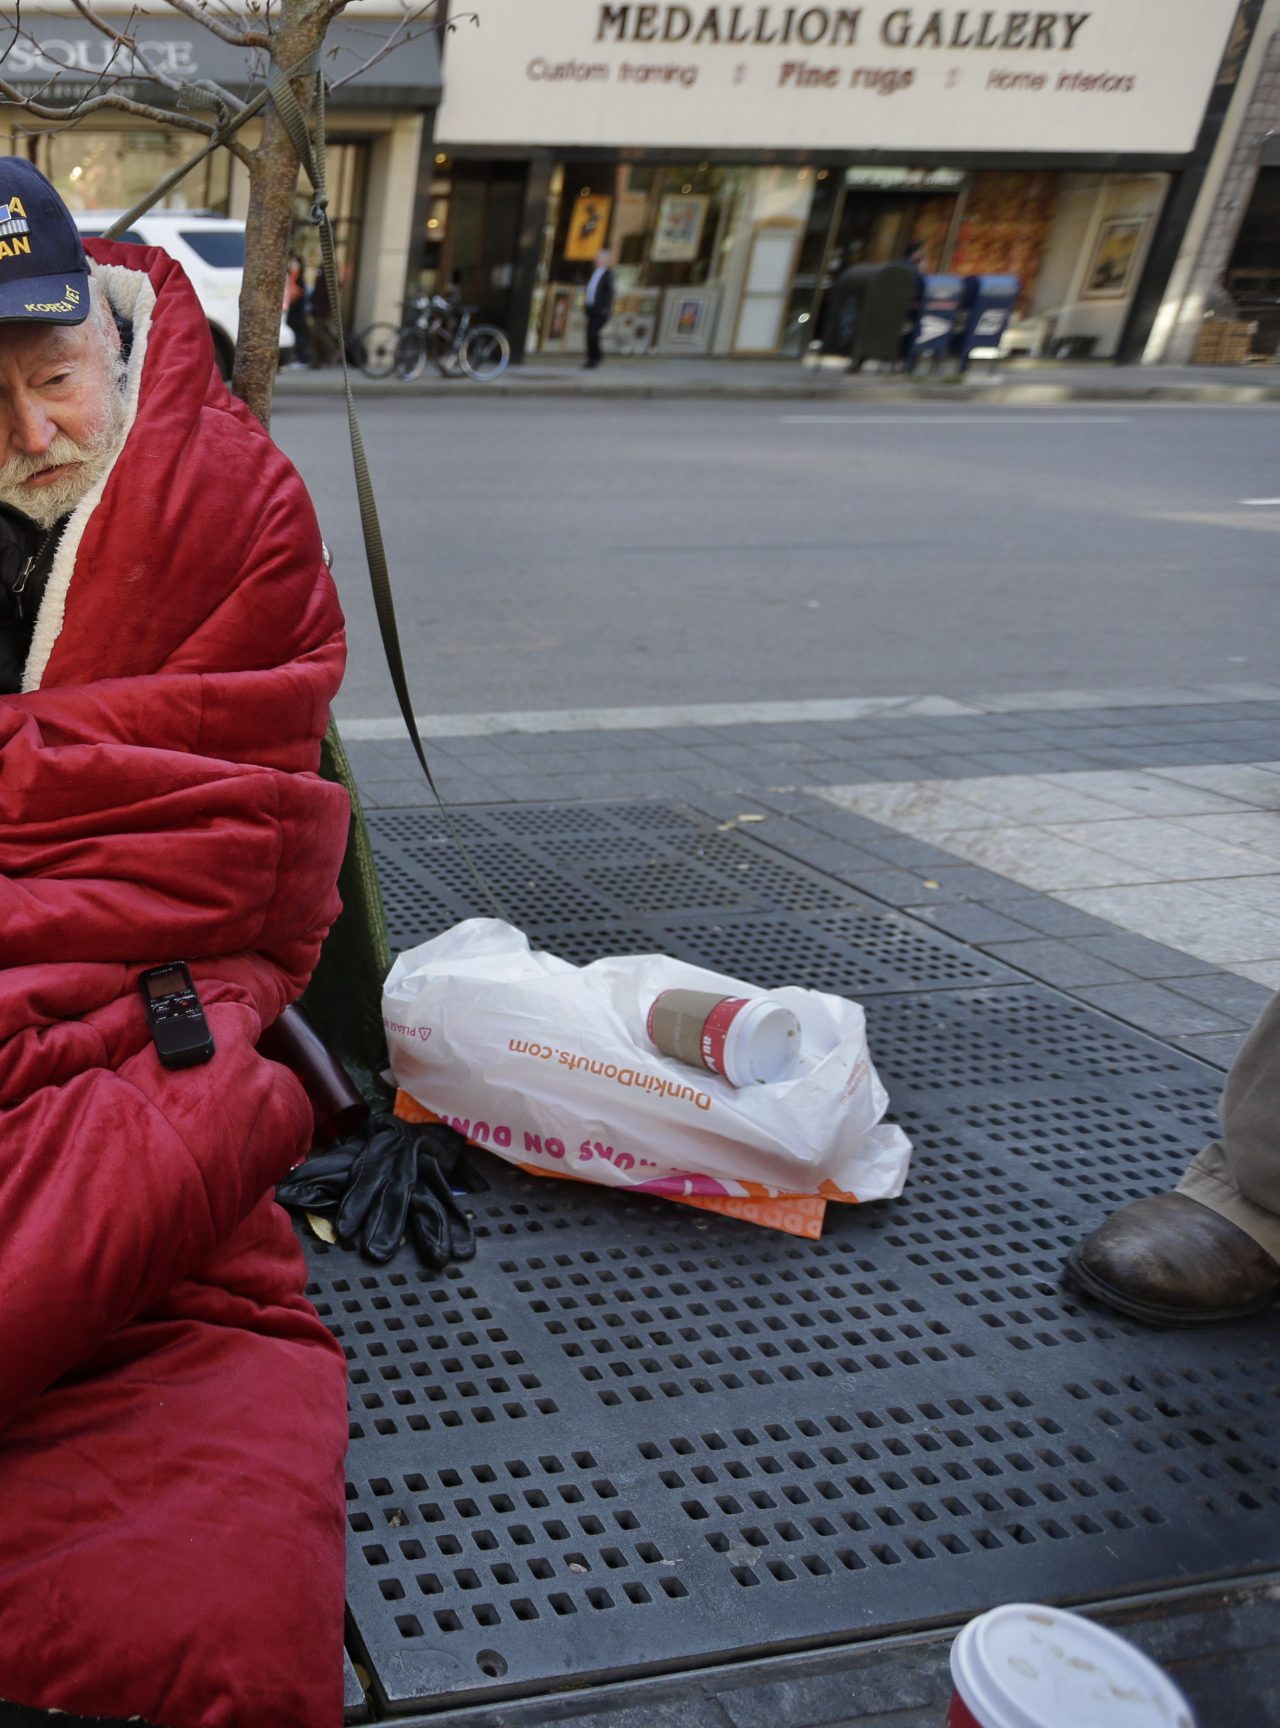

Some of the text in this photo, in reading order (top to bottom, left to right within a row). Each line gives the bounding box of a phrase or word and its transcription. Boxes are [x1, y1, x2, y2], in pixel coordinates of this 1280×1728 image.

[595, 4, 1092, 50] MEDALLION GALLERY
[8, 38, 198, 75] SOURCE
[526, 58, 1136, 95] Custom framing Fine rugs Home interiors
[24, 284, 81, 314] KOREA VET
[508, 1039, 712, 1111] DunkinDonuts.com
[524, 1131, 565, 1159] ON
